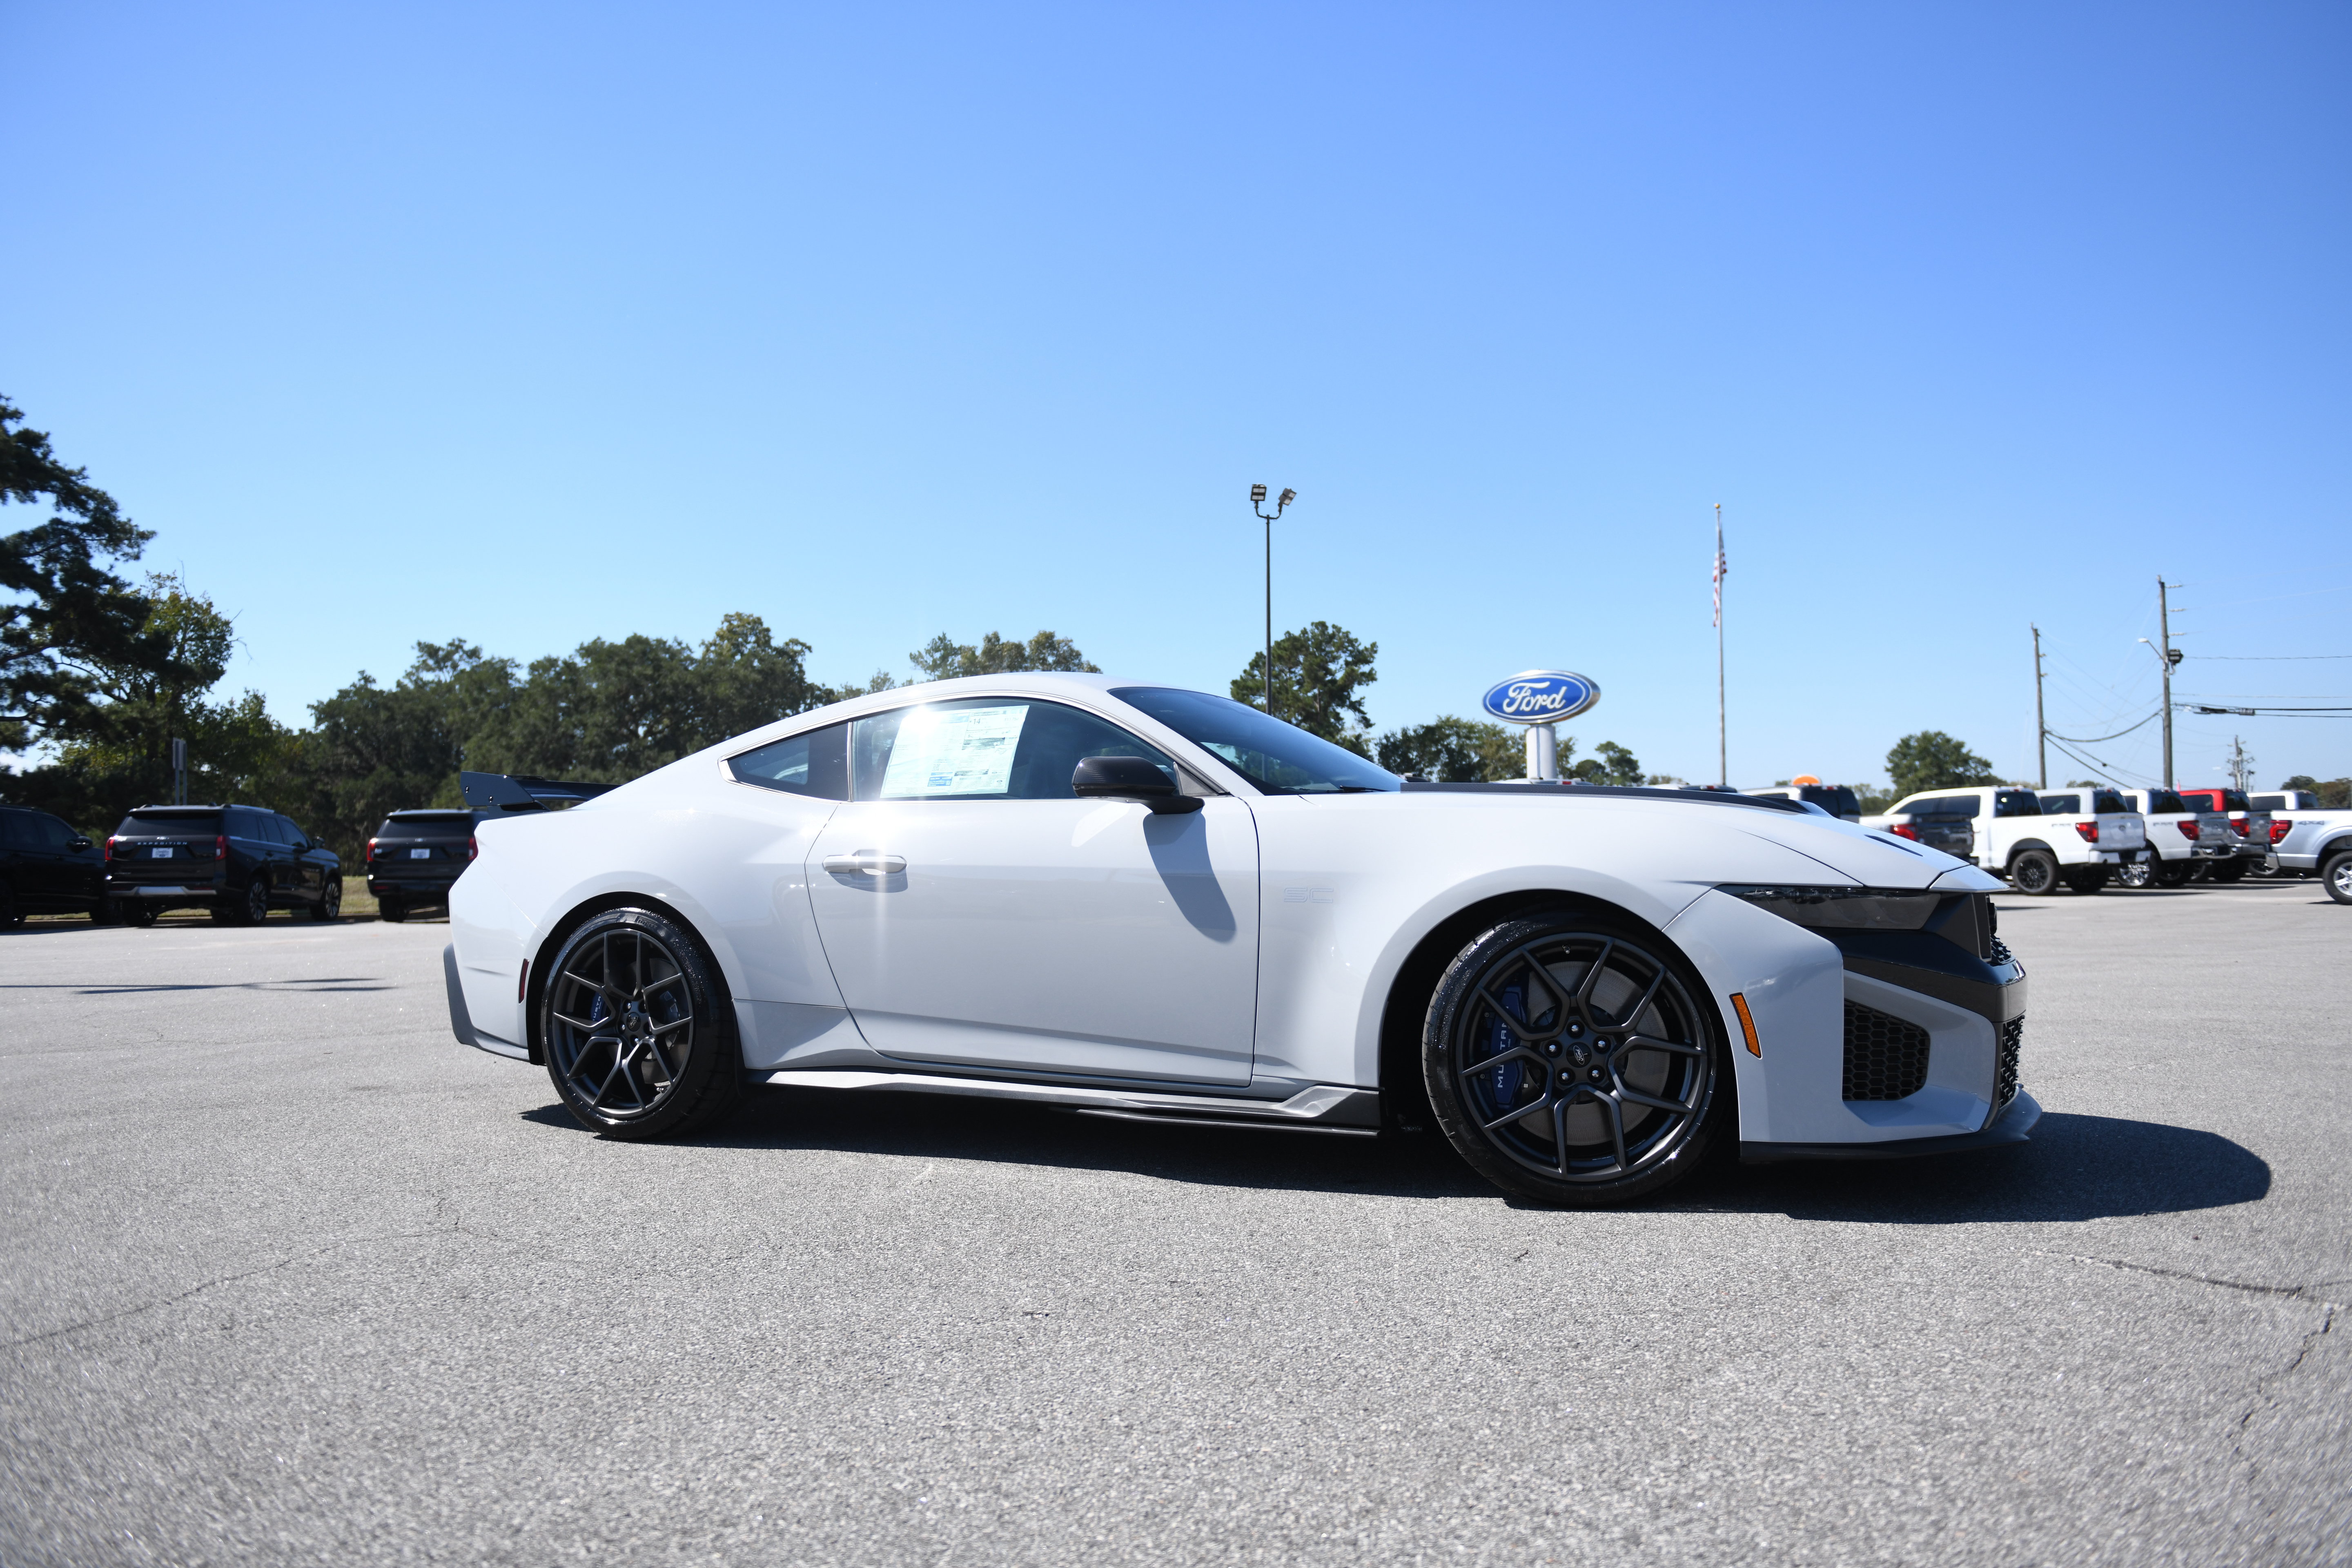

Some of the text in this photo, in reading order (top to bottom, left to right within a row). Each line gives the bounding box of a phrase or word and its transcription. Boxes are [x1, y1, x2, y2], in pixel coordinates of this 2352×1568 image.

[1503, 681, 1567, 713] Ford
[1284, 887, 1334, 903] SC
[1575, 1049, 1584, 1061] Ford
